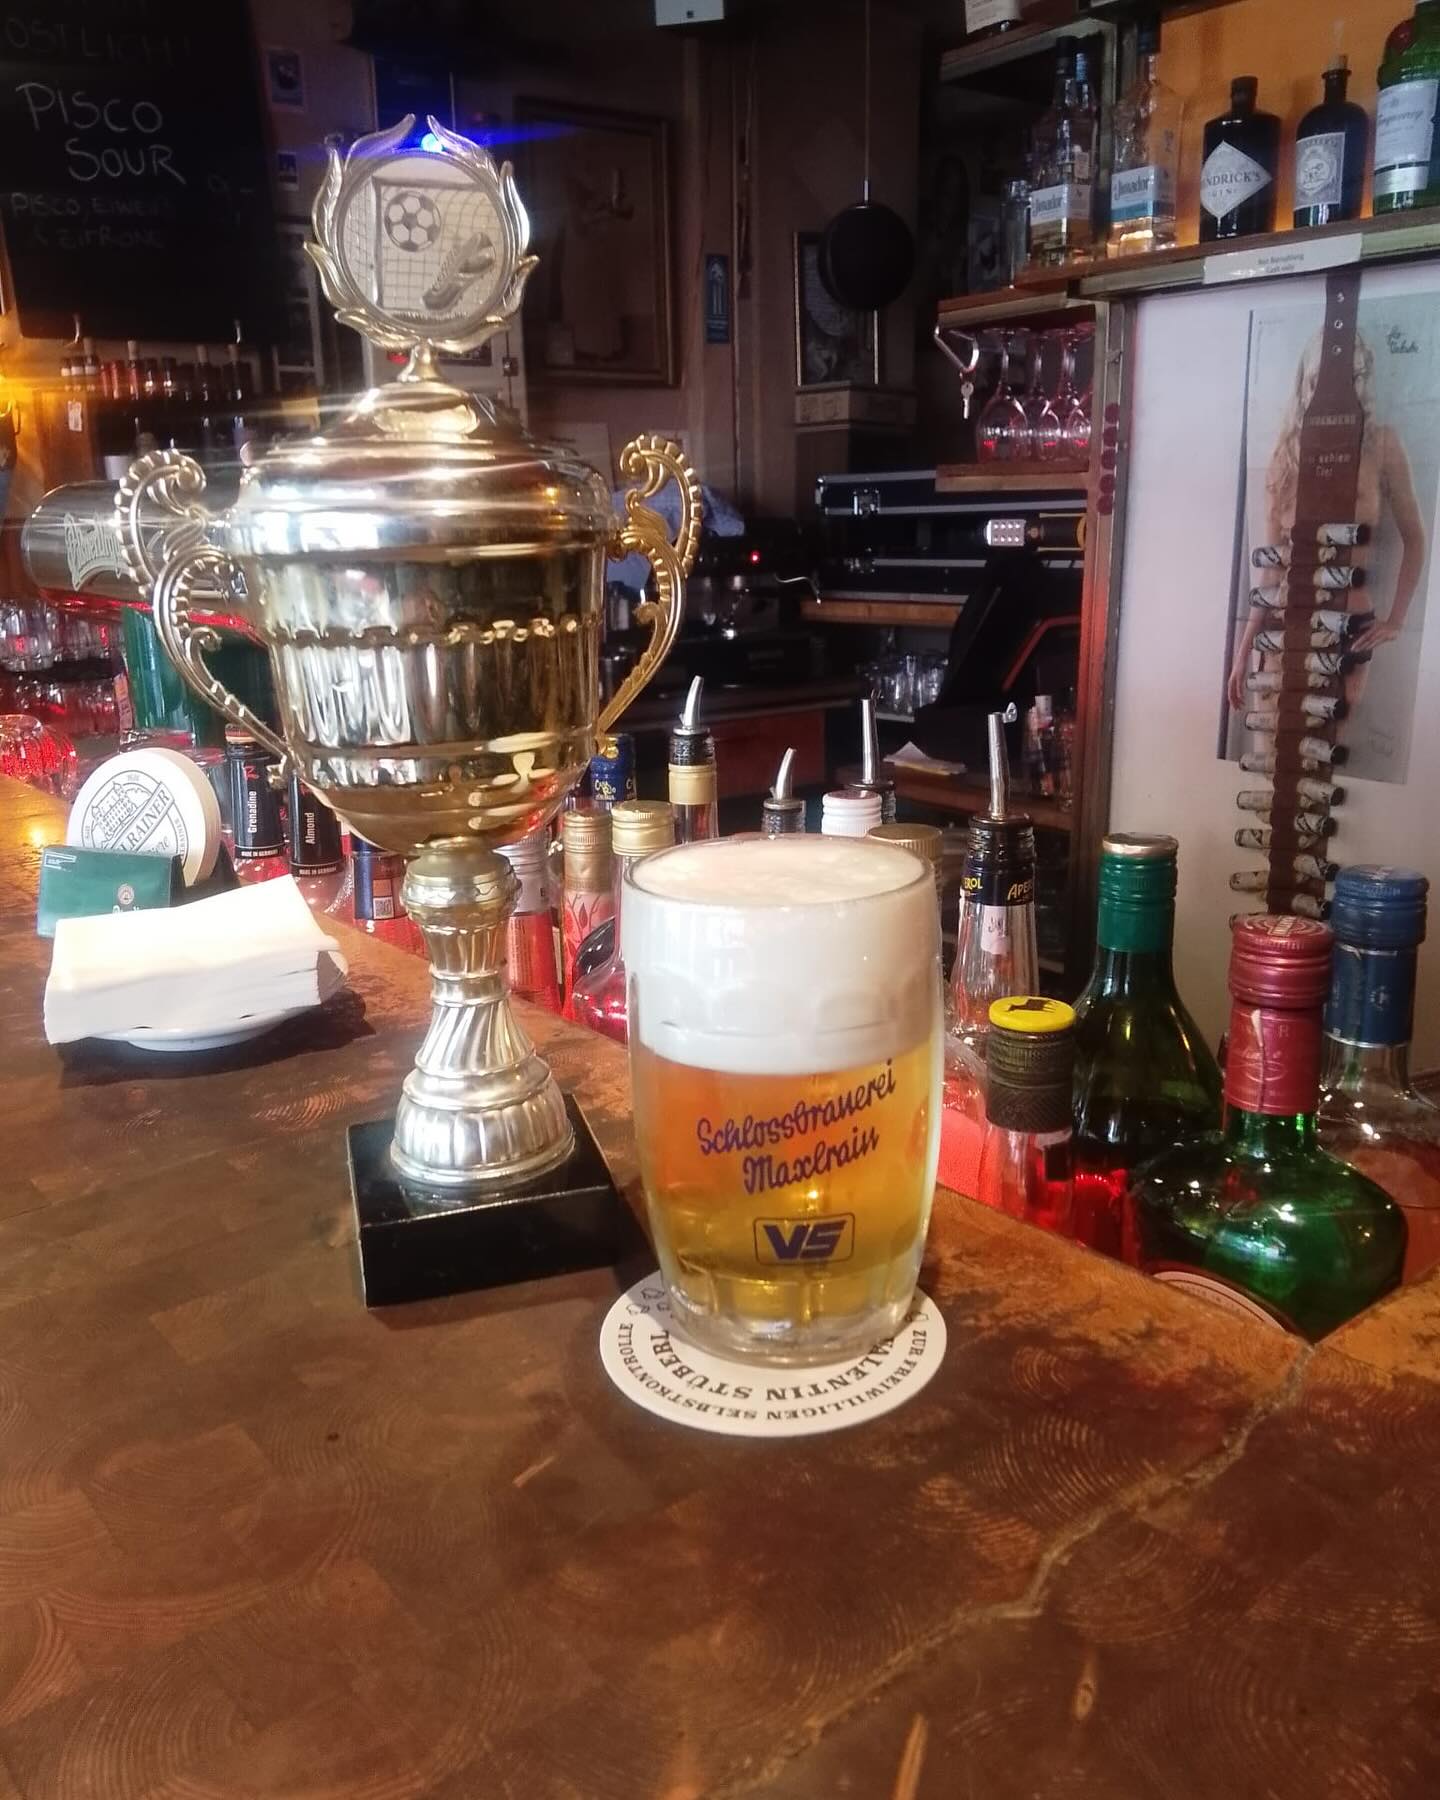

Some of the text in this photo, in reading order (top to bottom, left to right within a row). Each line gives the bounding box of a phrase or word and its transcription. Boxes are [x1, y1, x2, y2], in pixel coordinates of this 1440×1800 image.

[16, 82, 162, 133] PISCO
[65, 138, 187, 184] SOUR
[247, 790, 258, 833] Grenadine
[304, 812, 316, 845] Almond
[697, 1058, 896, 1155] Schlossbrauerei
[743, 1125, 880, 1195] Maxlrain
[762, 1219, 850, 1260] VS
[618, 1323, 926, 1420] ZUR FREIWILLIGEN SELBSTKONTROLLE
